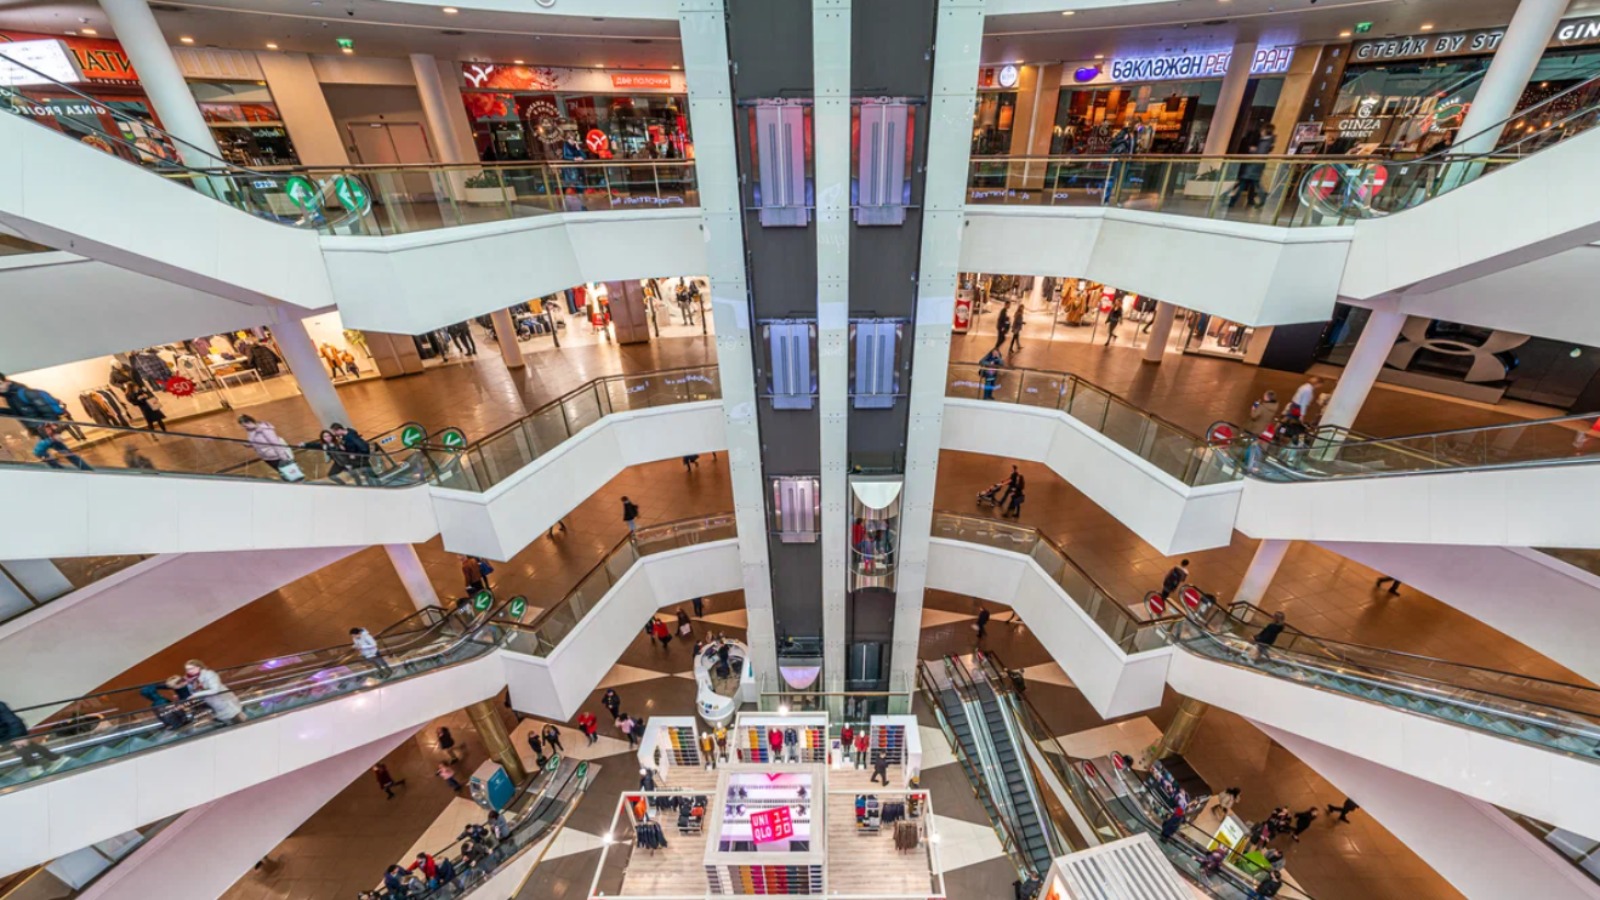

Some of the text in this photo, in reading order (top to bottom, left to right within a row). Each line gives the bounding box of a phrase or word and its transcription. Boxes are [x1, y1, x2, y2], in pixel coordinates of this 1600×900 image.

[1358, 36, 1426, 59] СТЕЙК
[1435, 36, 1464, 53] BY
[1338, 119, 1381, 131] GINZA
[1340, 130, 1374, 138] PROJECT
[752, 814, 769, 826] UNI
[754, 826, 772, 841] QLO
